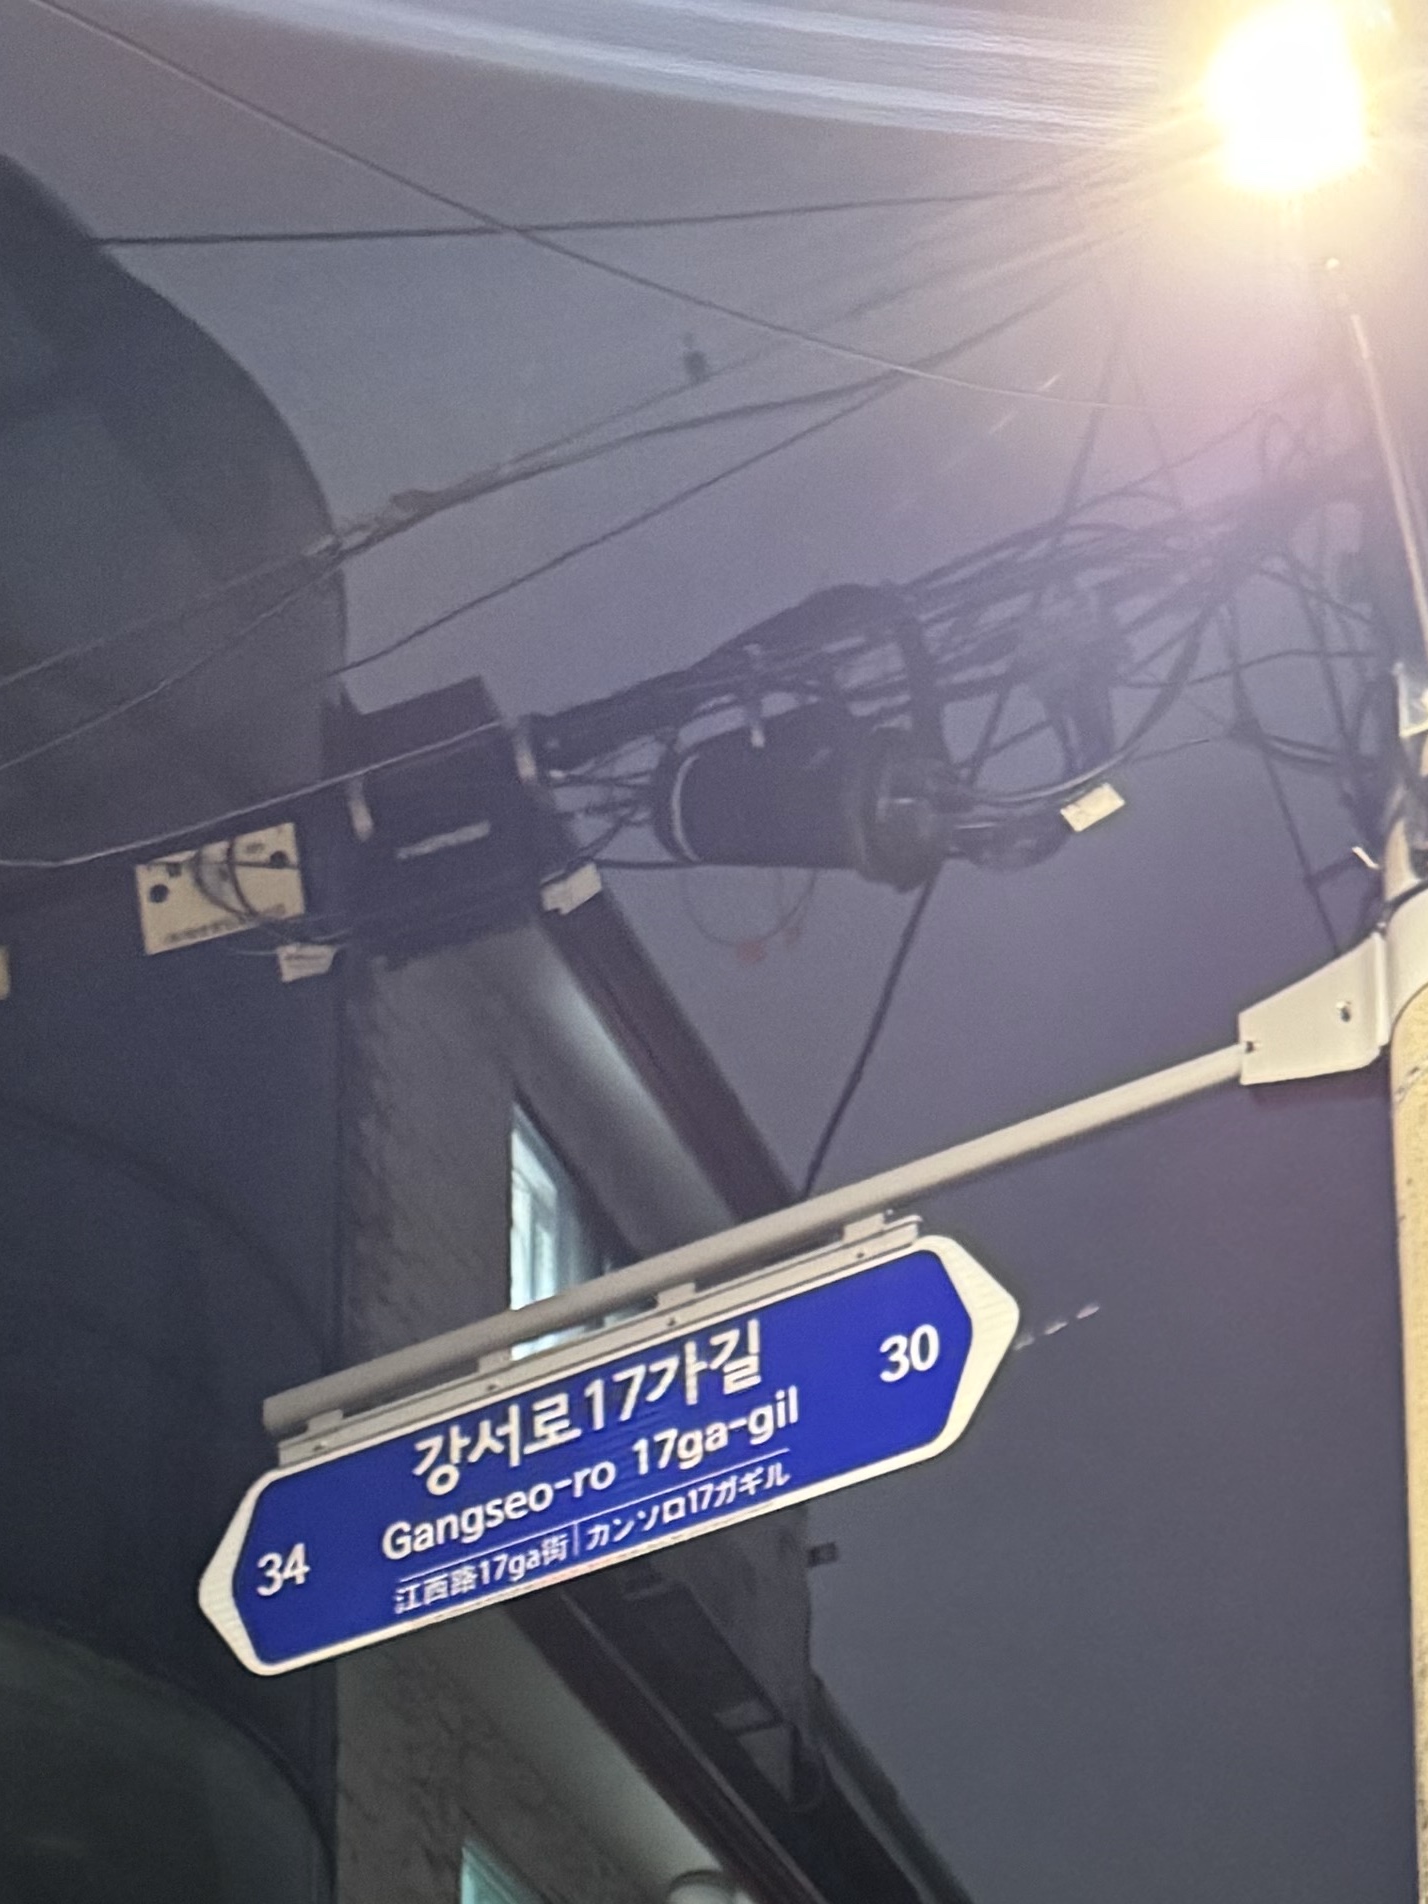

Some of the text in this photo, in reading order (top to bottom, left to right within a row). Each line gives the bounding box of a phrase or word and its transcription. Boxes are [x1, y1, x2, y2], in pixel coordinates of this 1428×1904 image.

[412, 1318, 762, 1496] 강서로17가길
[879, 1323, 940, 1383] 30
[381, 1386, 800, 1560] Gangseo-ro 17ga-gil
[256, 1543, 311, 1597] 34
